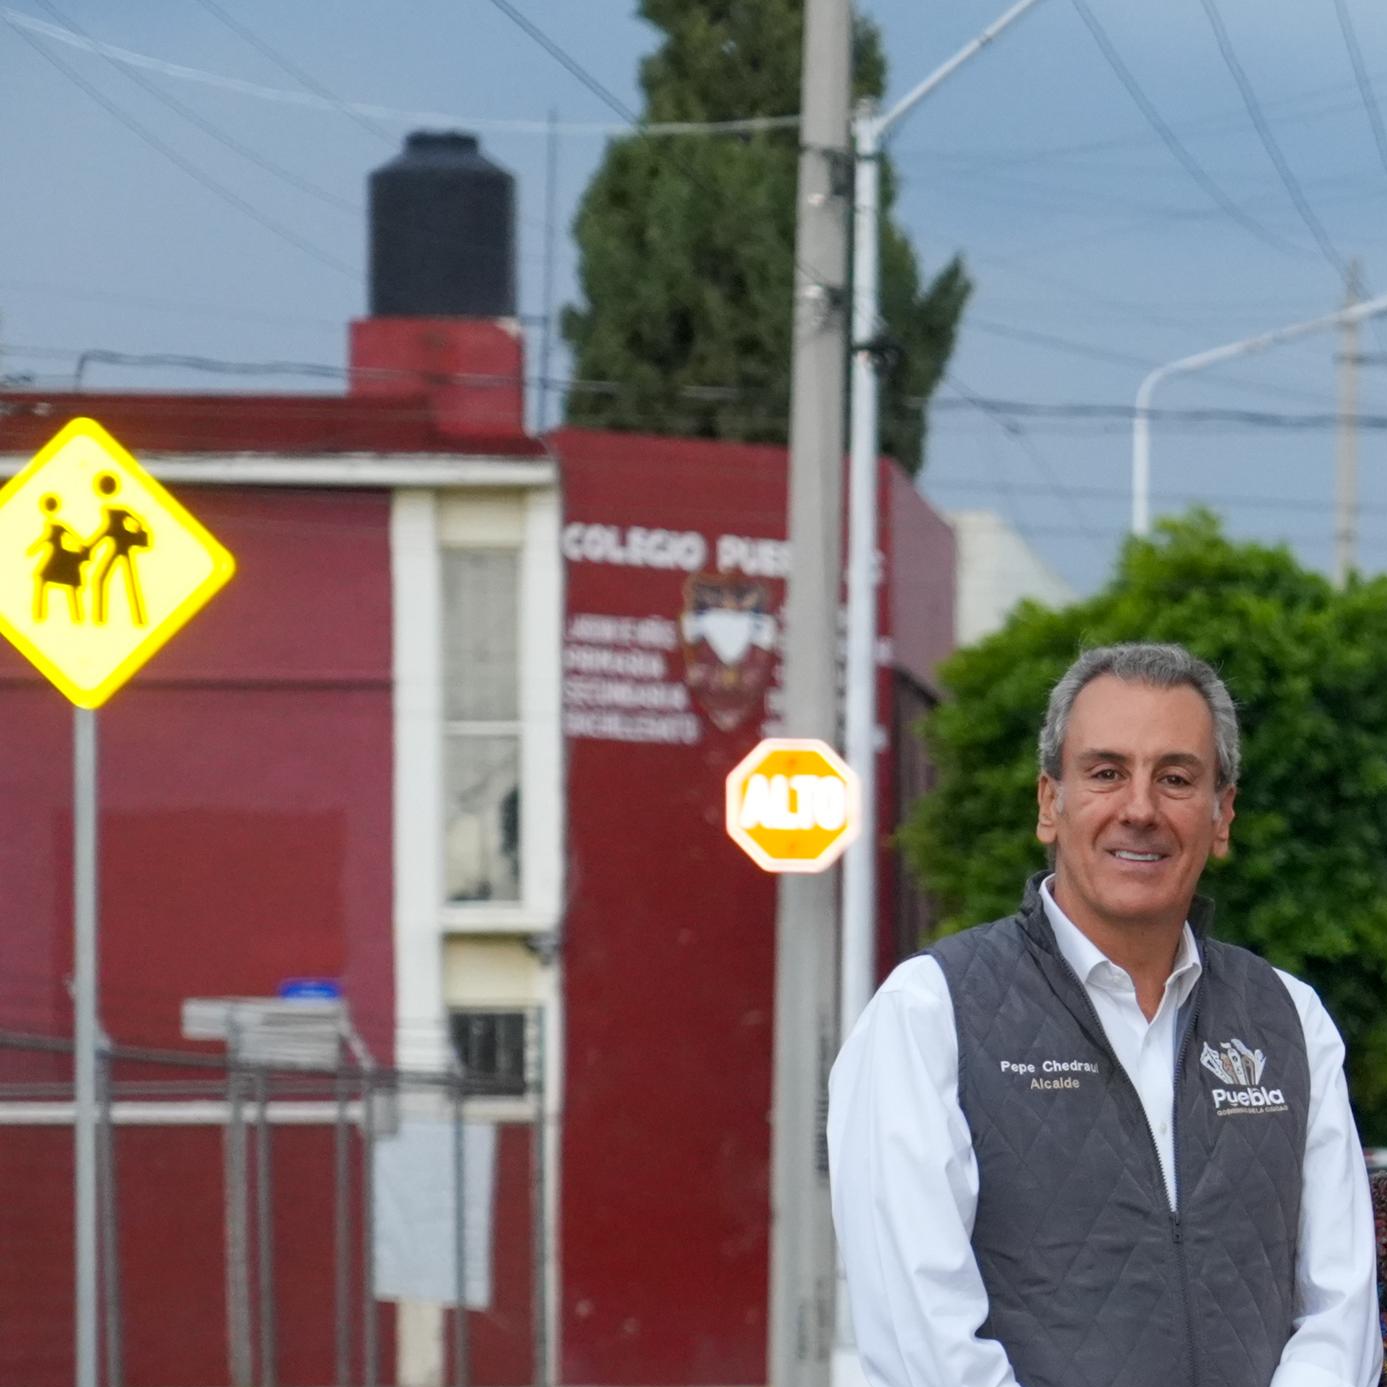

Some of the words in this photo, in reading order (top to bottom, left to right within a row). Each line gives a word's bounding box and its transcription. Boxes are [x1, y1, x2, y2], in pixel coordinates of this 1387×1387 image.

[562, 523, 706, 572] COLEGIO
[739, 774, 846, 831] ALTO
[1000, 1061, 1035, 1074] Pepe
[1030, 1077, 1080, 1090] Alcalde
[1212, 1086, 1285, 1109] Puebla
